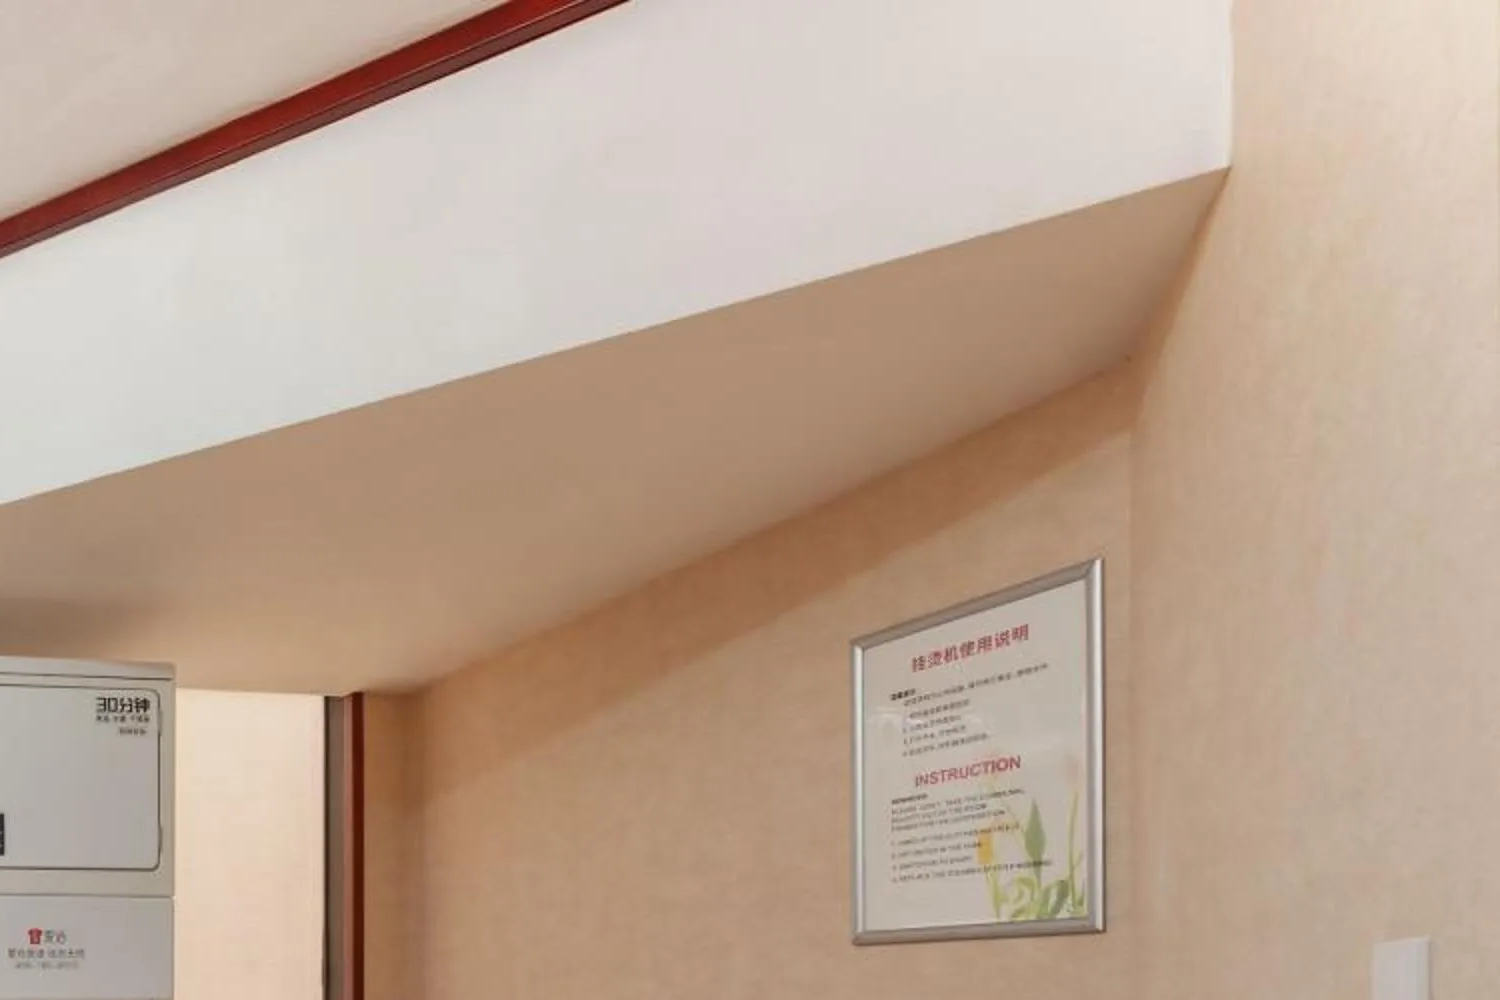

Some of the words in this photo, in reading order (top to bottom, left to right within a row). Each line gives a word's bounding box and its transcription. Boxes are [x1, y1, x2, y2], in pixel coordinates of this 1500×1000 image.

[912, 624, 1029, 673] 挂烫机使用说明
[96, 697, 150, 713] 30分钟
[915, 755, 1021, 787] INSTRUCTION
